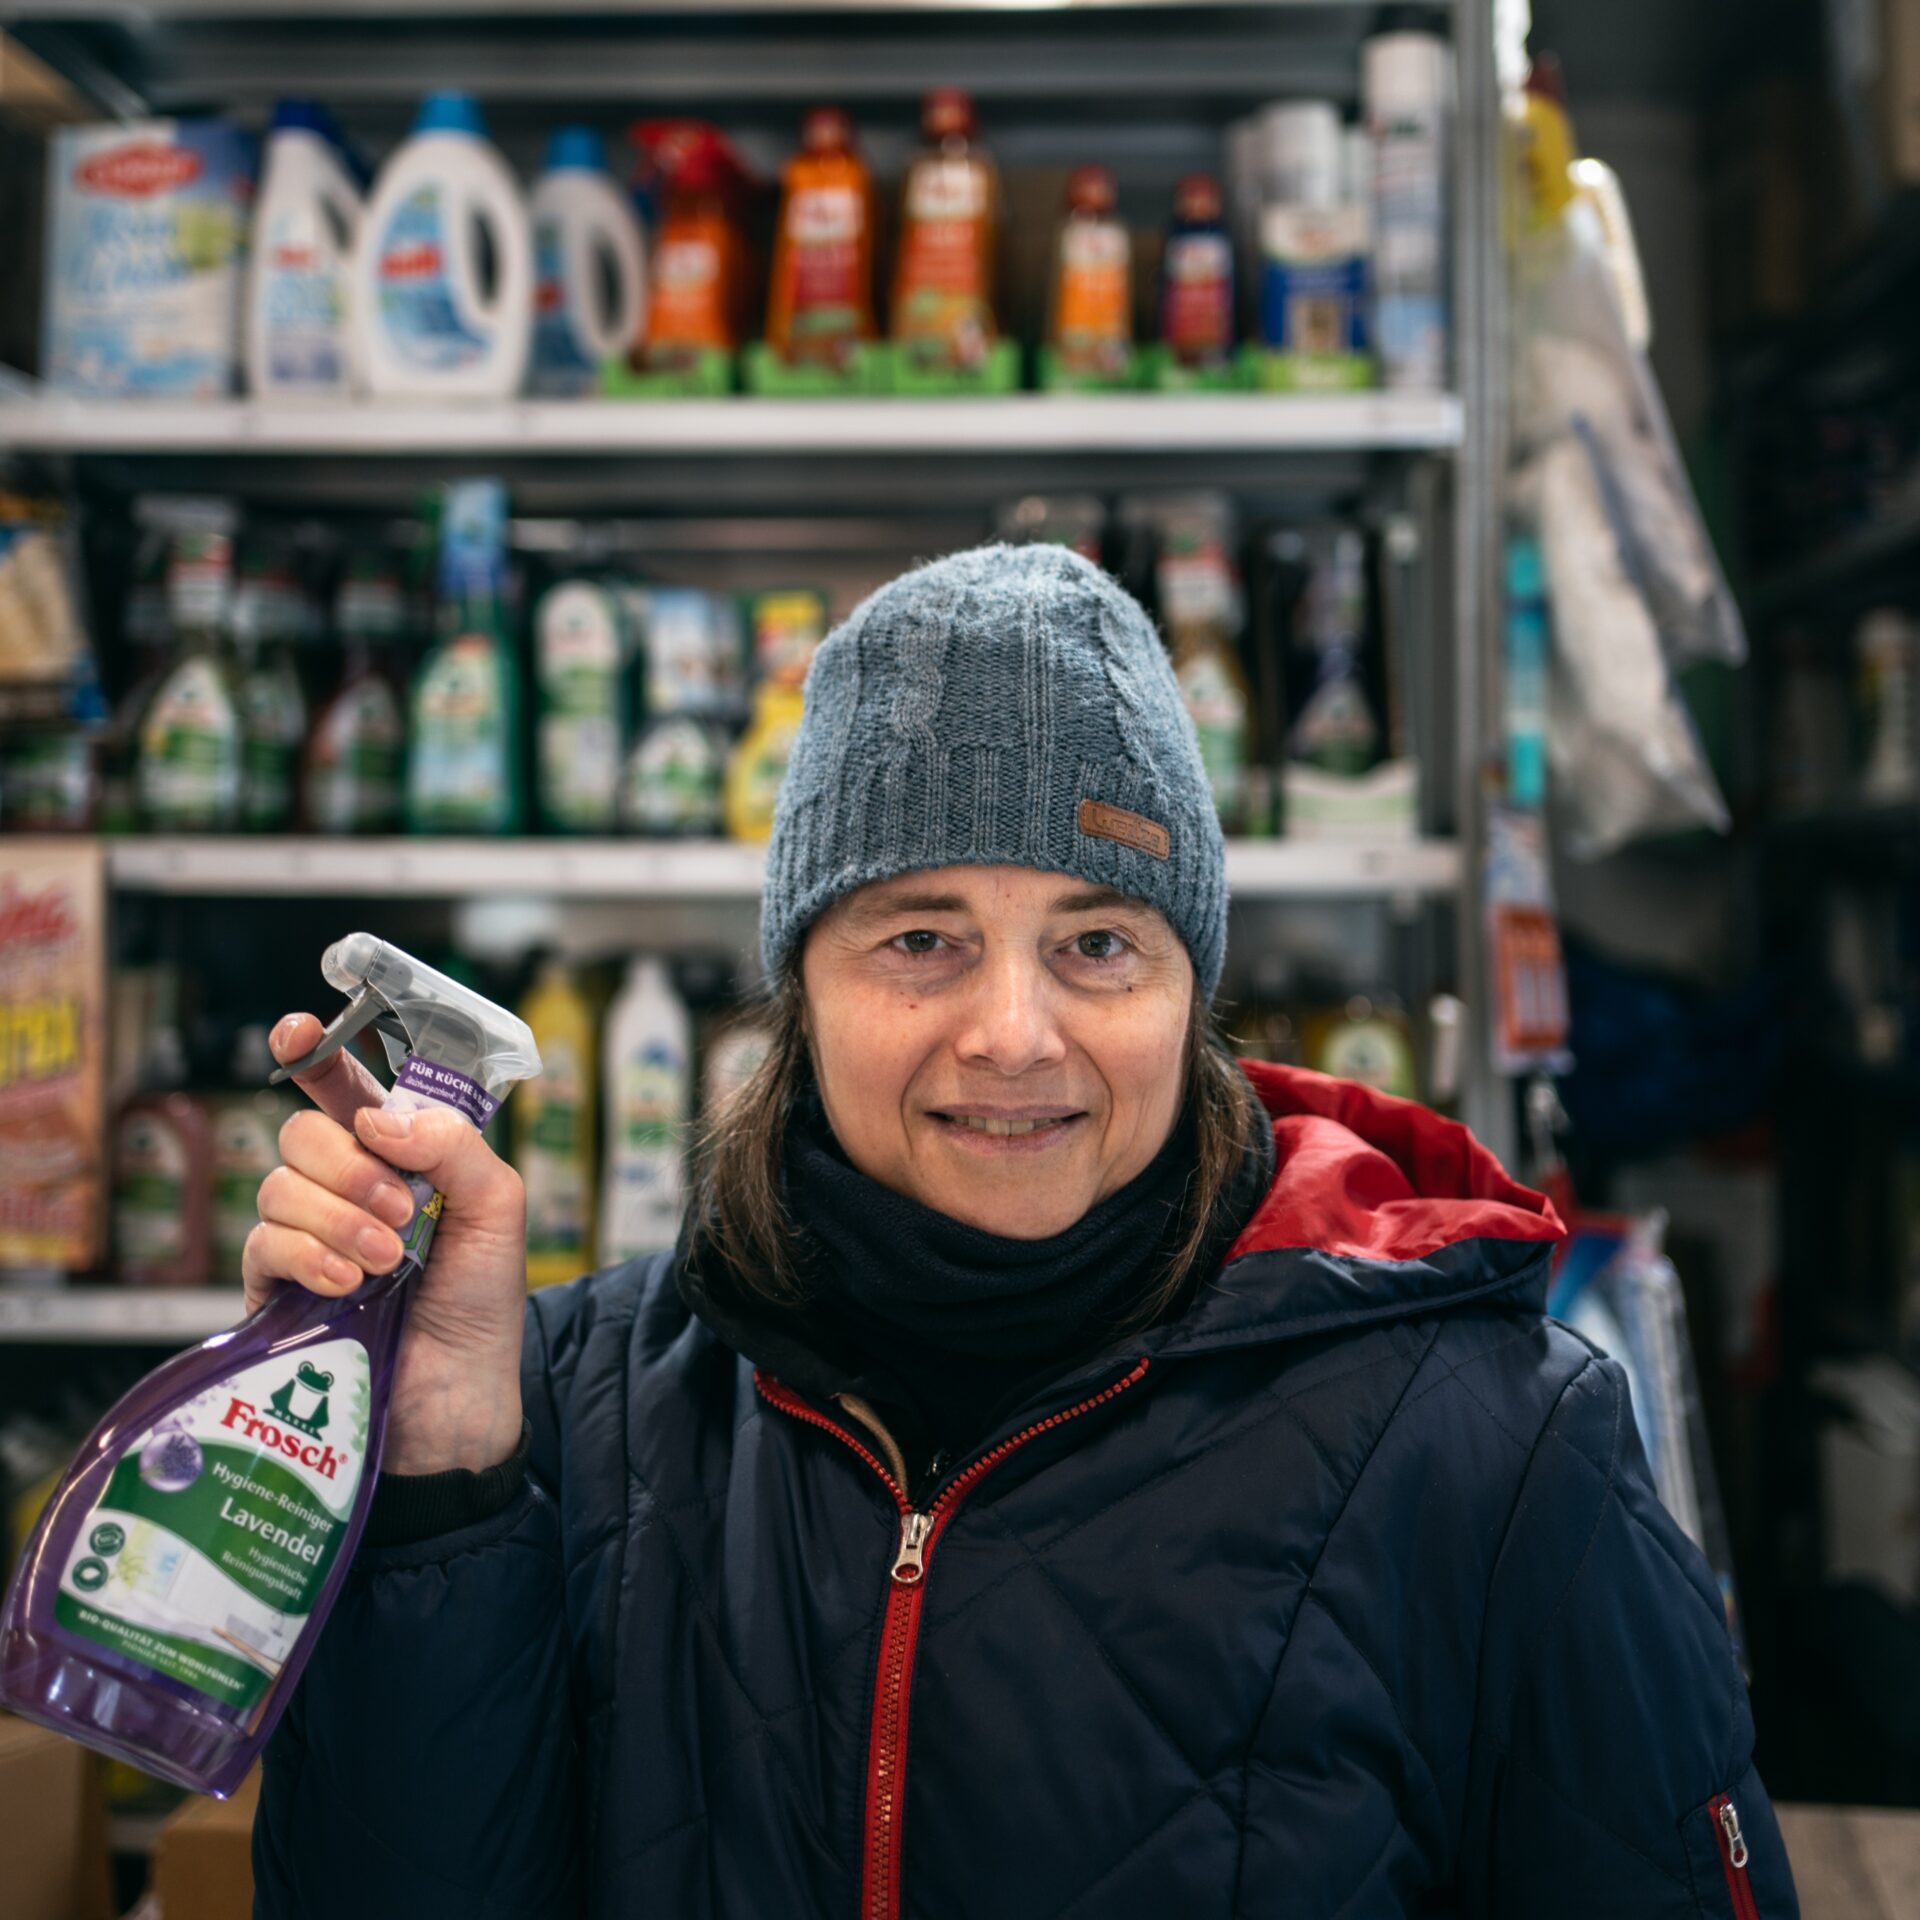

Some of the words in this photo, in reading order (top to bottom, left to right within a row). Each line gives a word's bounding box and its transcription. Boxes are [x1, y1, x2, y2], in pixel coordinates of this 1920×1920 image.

[409, 1061, 434, 1079] FÜR
[435, 1071, 474, 1096] KÜCHE
[212, 1461, 334, 1534] Hygiene-Reiniger
[220, 1496, 325, 1566] Lavendel
[153, 1642, 178, 1659] ZUM
